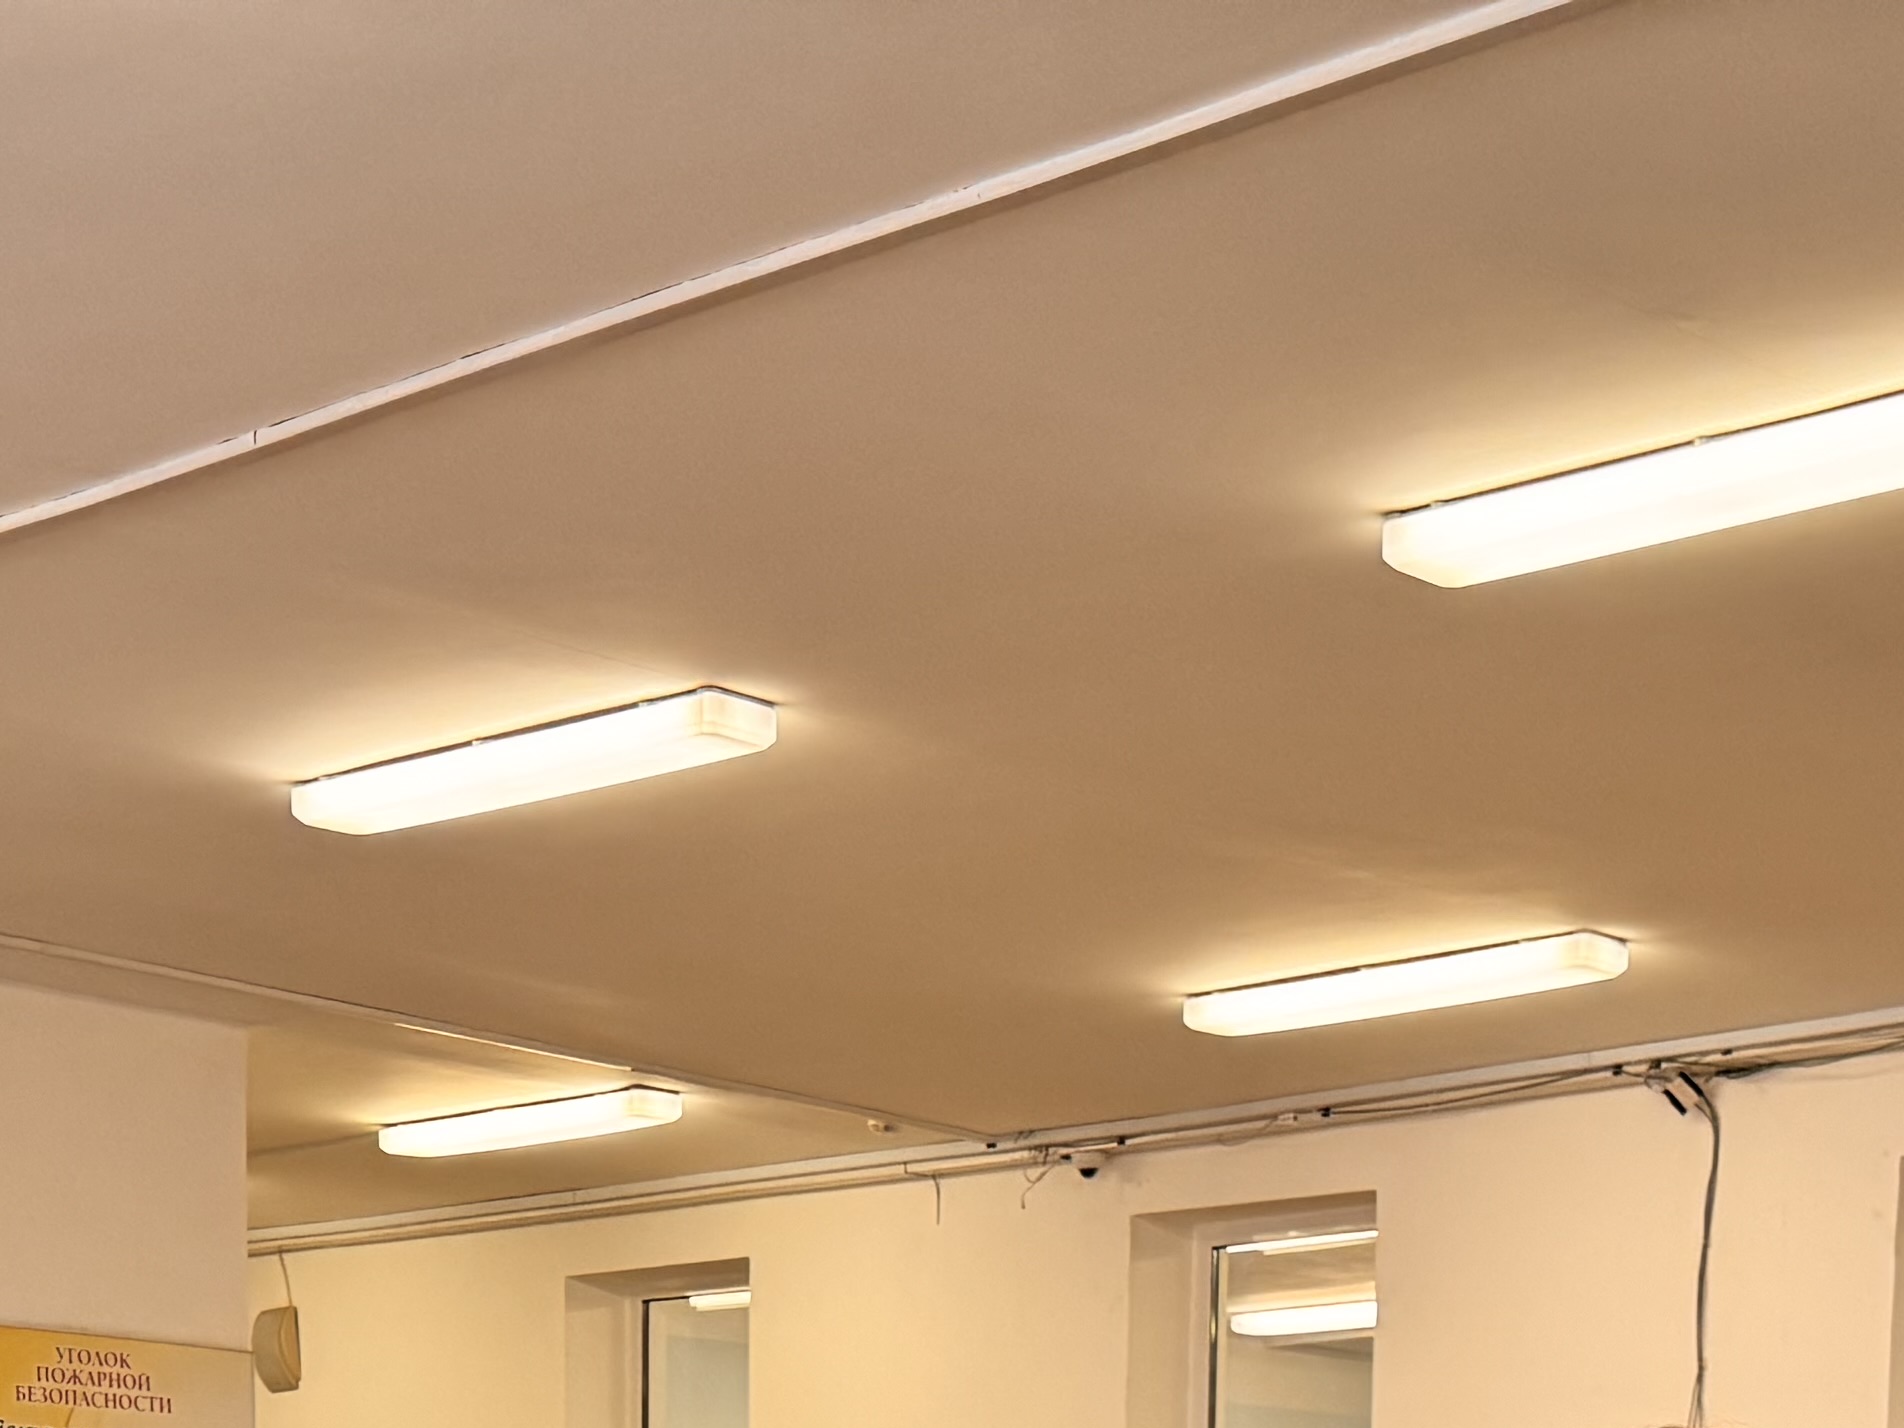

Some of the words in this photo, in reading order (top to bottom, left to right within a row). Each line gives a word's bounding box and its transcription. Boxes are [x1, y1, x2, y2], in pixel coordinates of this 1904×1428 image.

[56, 1346, 131, 1369] УГОЛОК
[36, 1365, 151, 1391] ПОЖАРНОЙ
[16, 1385, 172, 1414] БЕЗОПАСНОСТИ
